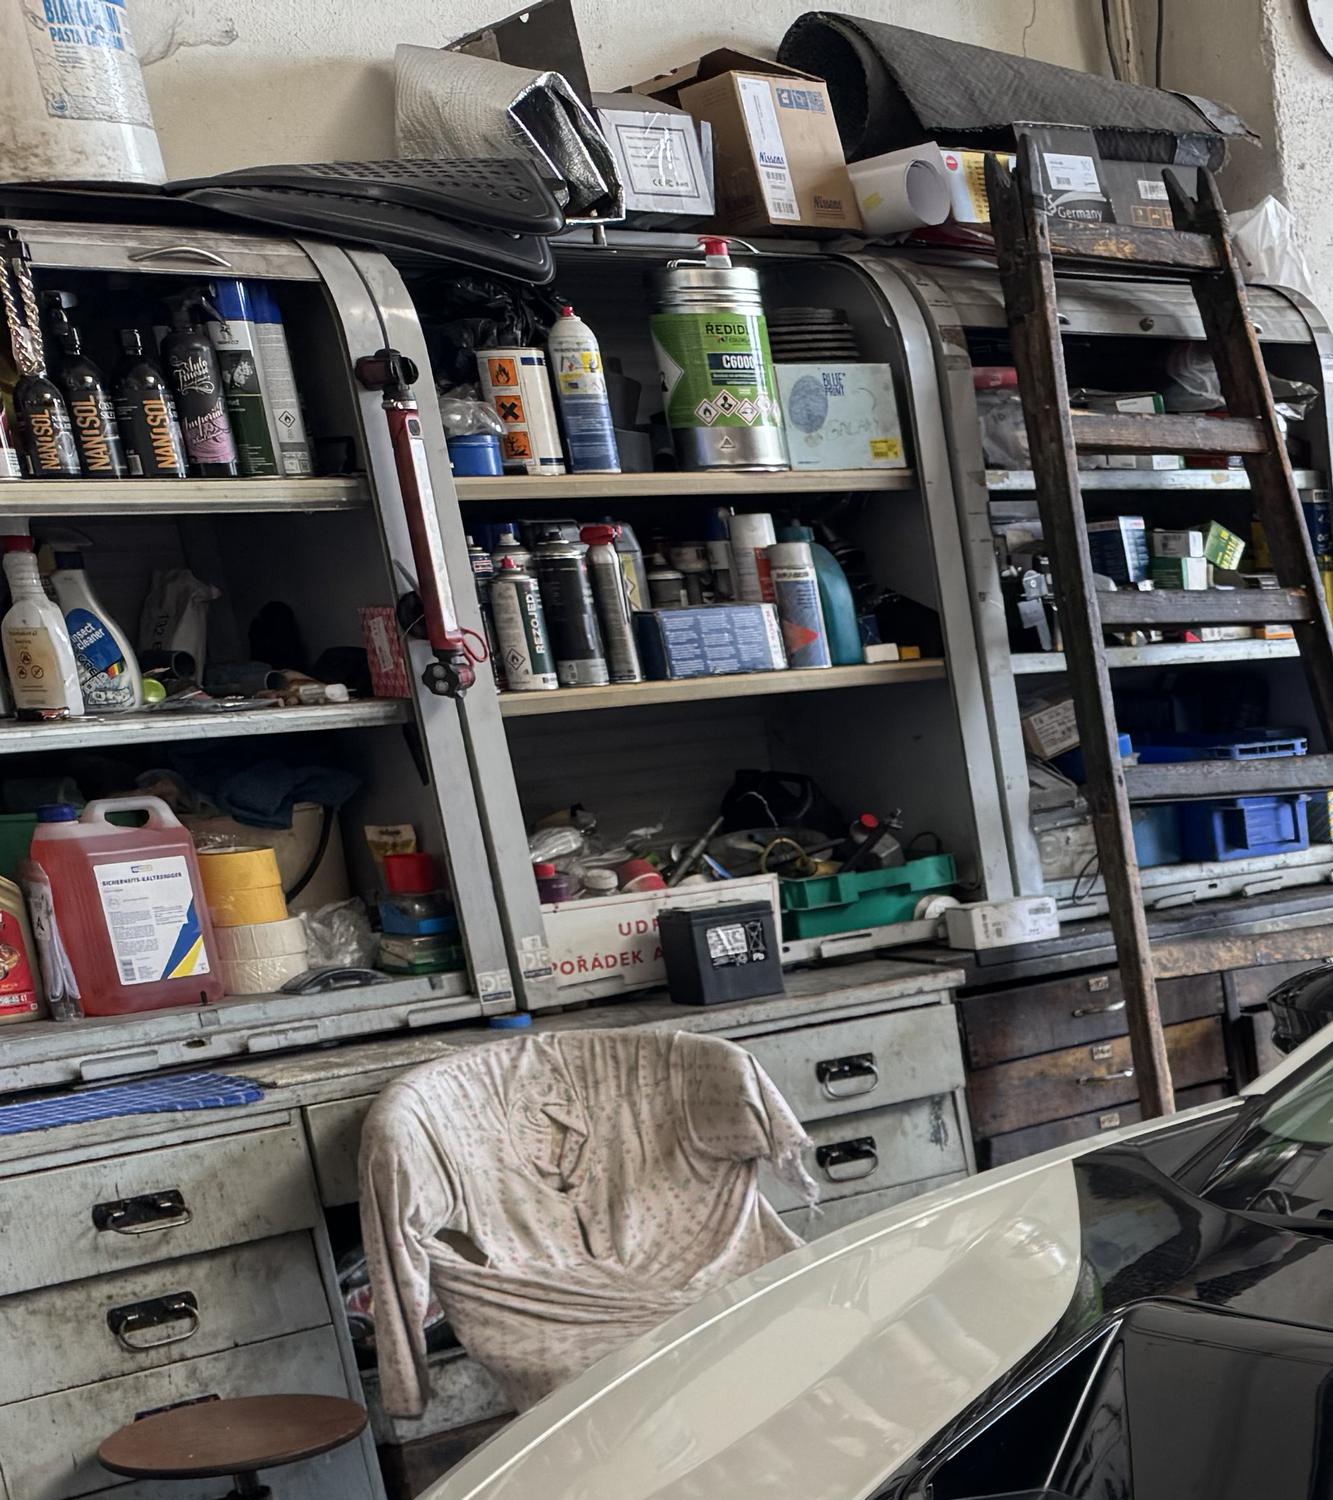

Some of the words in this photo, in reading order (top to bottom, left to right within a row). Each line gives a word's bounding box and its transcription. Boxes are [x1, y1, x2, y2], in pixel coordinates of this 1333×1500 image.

[1058, 206, 1103, 224] Germany
[822, 372, 843, 387] BLUE
[525, 593, 546, 654] REZOJED
[77, 628, 105, 650] cleaner
[752, 952, 766, 962] Pb
